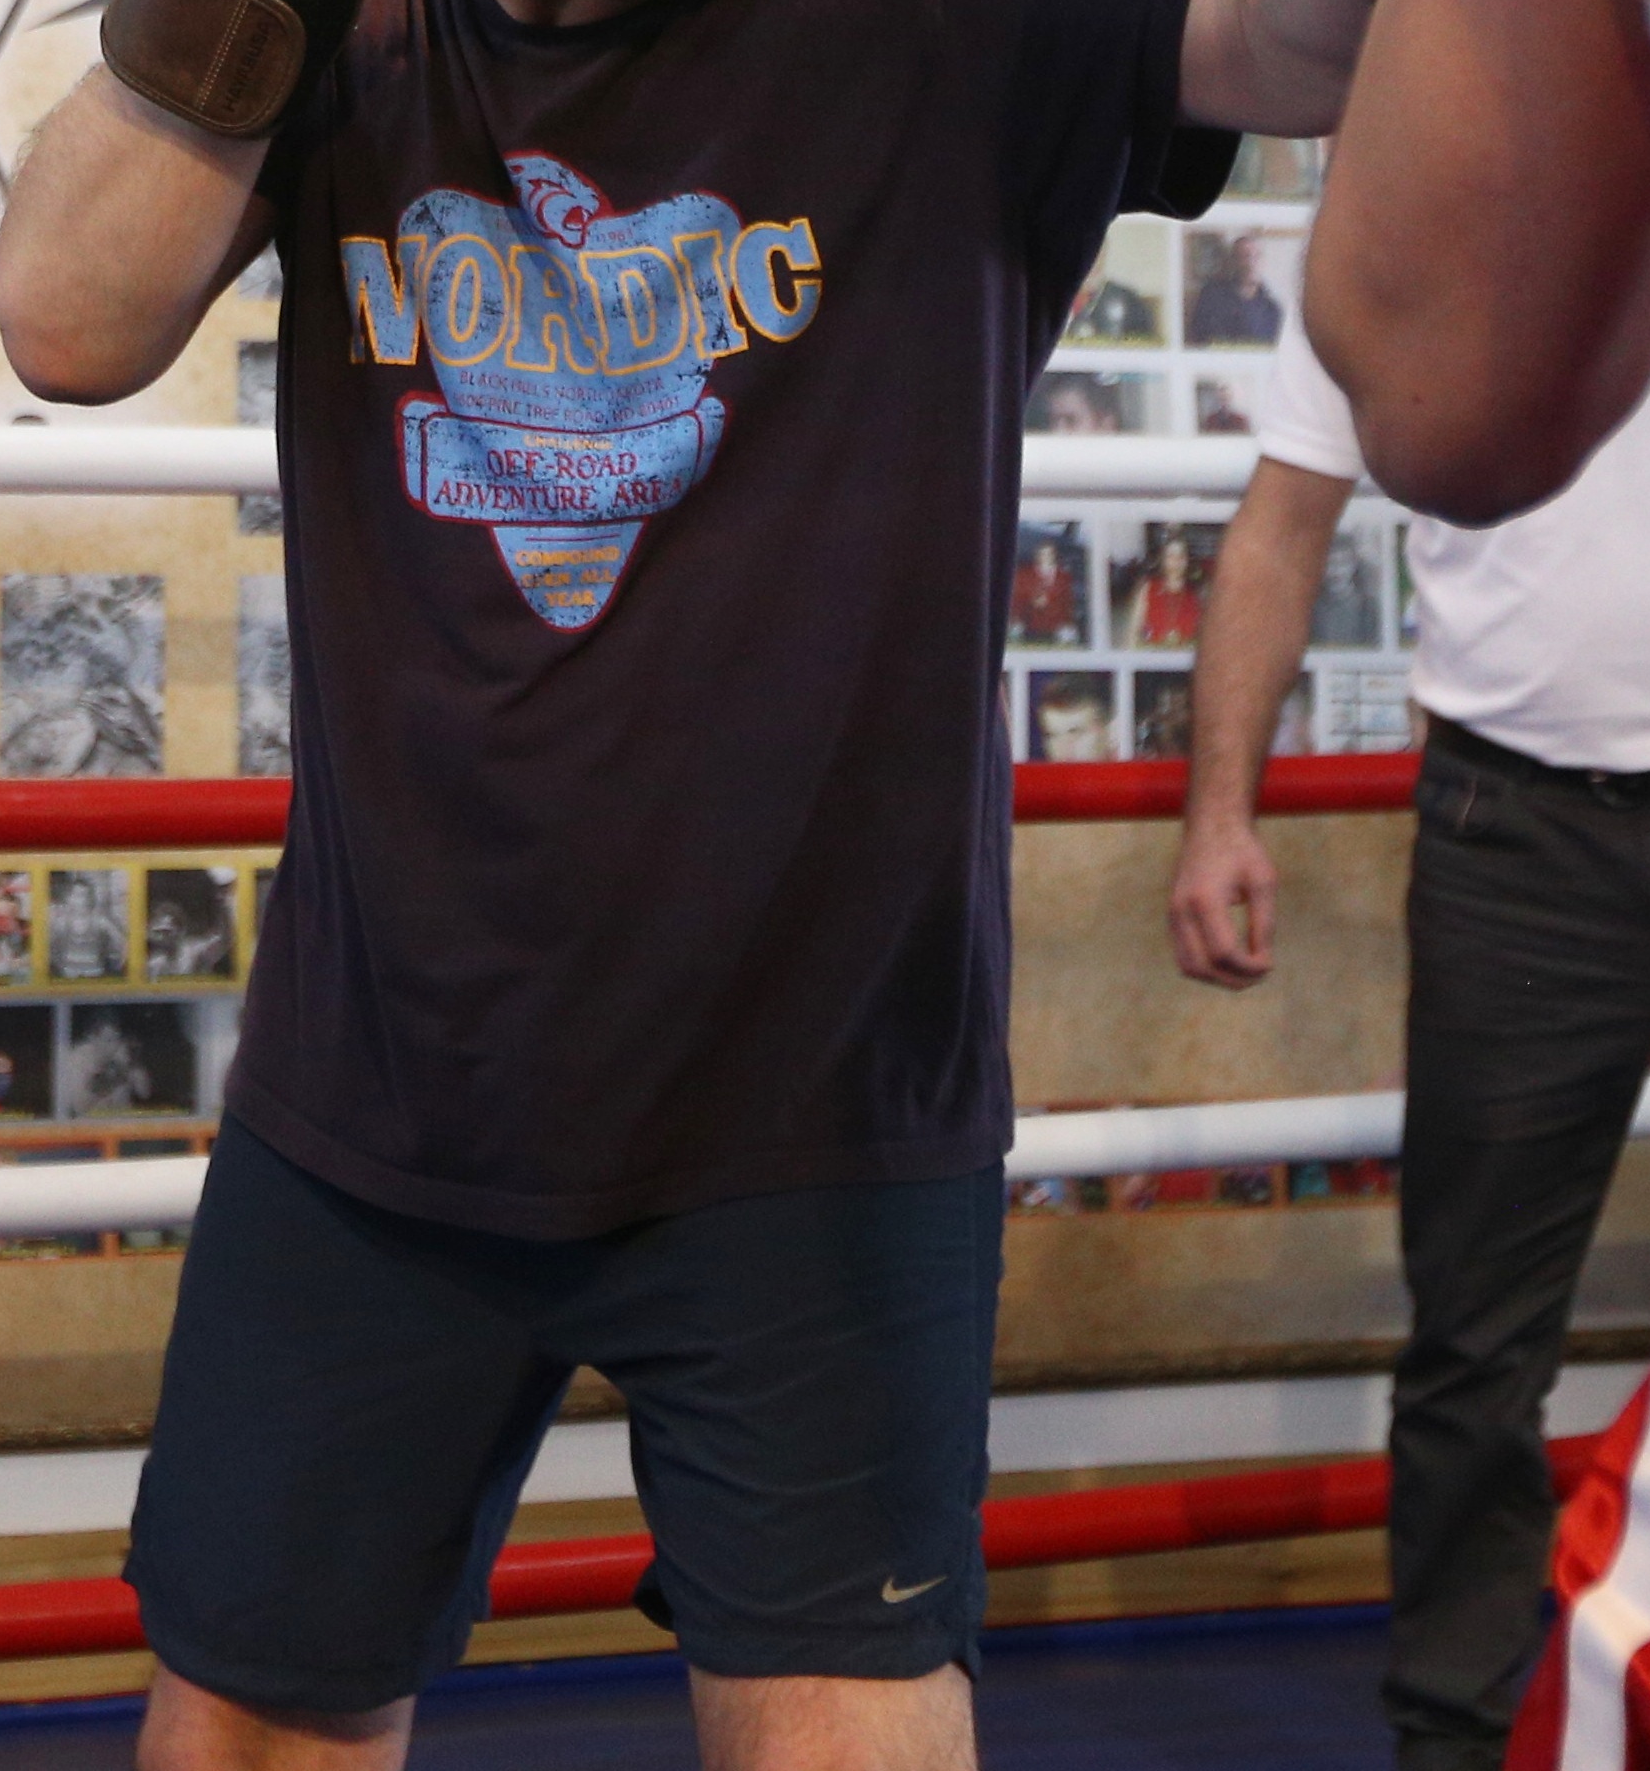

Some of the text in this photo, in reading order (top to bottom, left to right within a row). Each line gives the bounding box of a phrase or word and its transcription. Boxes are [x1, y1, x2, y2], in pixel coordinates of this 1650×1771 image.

[340, 218, 822, 376] NORDIC
[486, 449, 638, 479] OFF-ROAD
[434, 474, 683, 511] ADVENTURE AREA
[544, 589, 596, 608] YEAR
